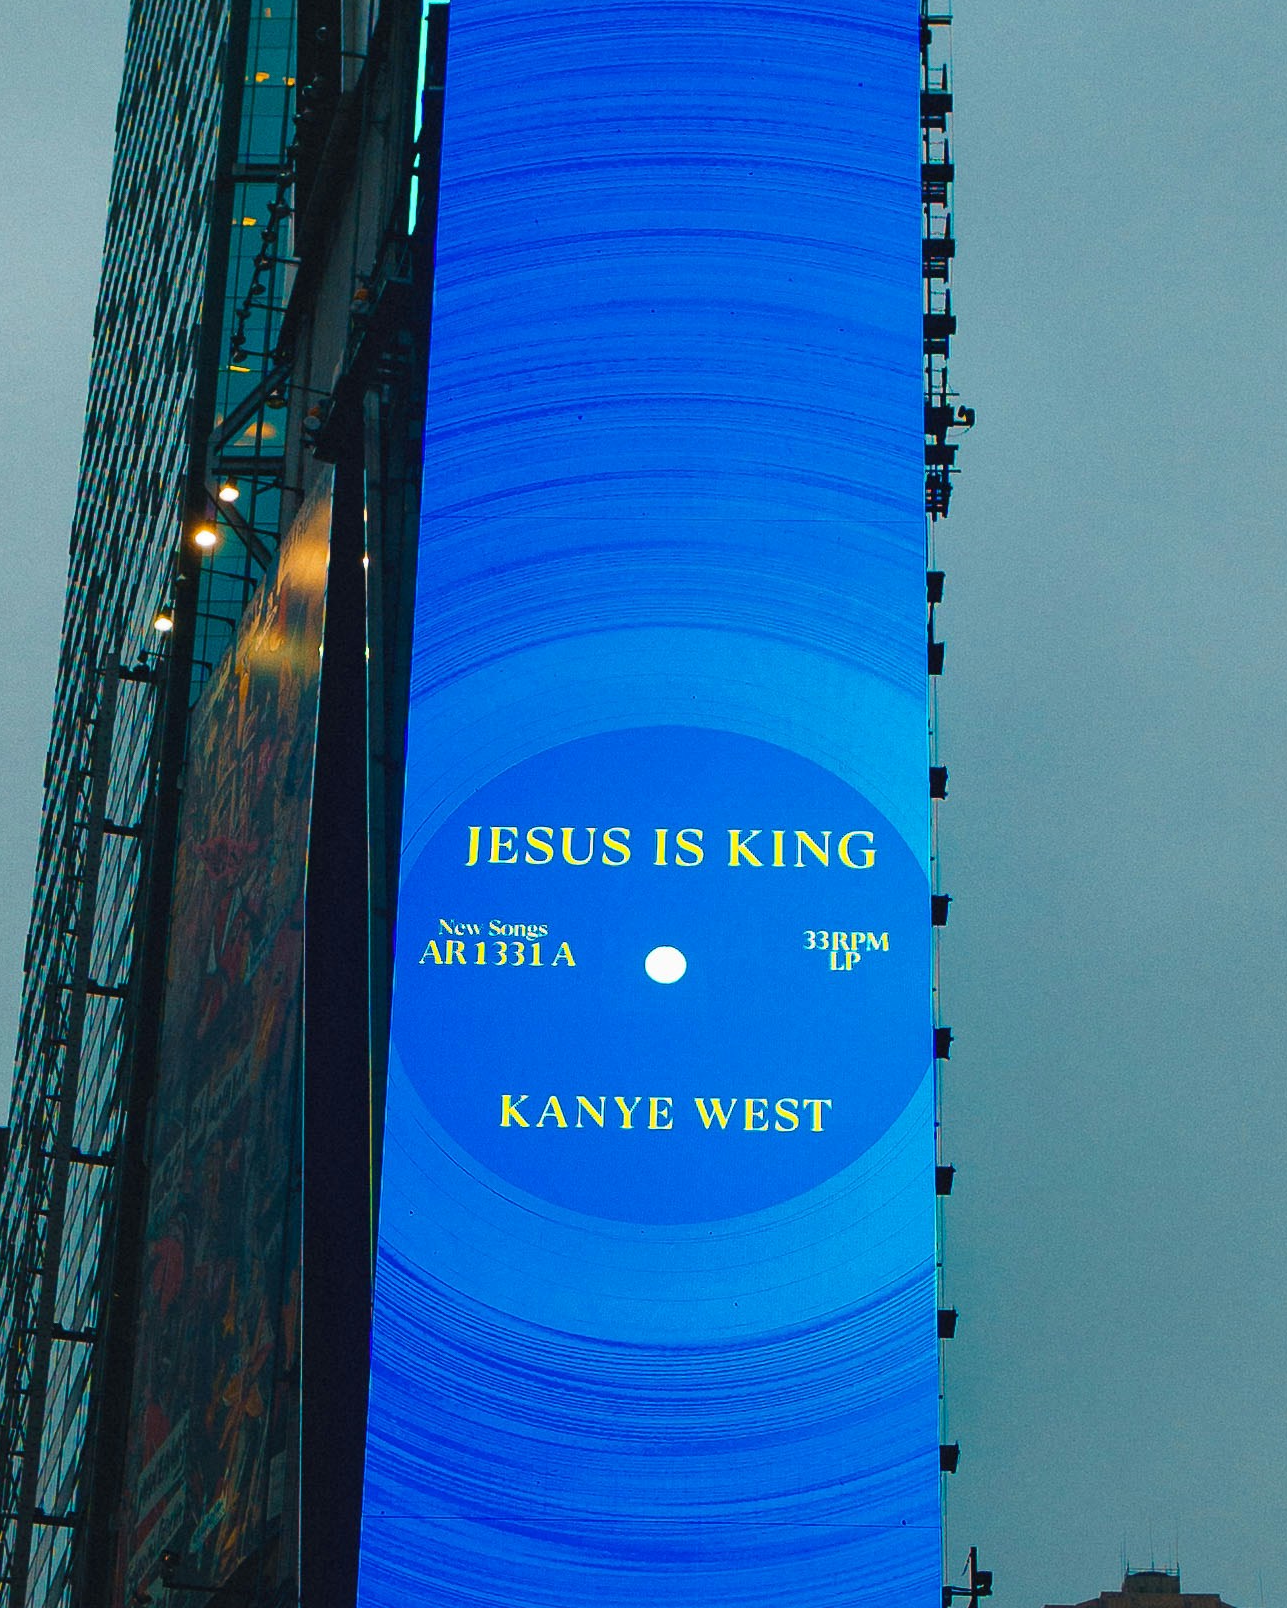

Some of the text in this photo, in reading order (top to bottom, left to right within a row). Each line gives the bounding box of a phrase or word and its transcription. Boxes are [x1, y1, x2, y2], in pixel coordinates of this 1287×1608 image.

[464, 825, 878, 871] JESUS IS KING
[438, 918, 548, 941] New Songs
[418, 939, 577, 967] AR 1331 A
[830, 951, 862, 971] LP
[500, 1093, 833, 1133] KANYE WEST
